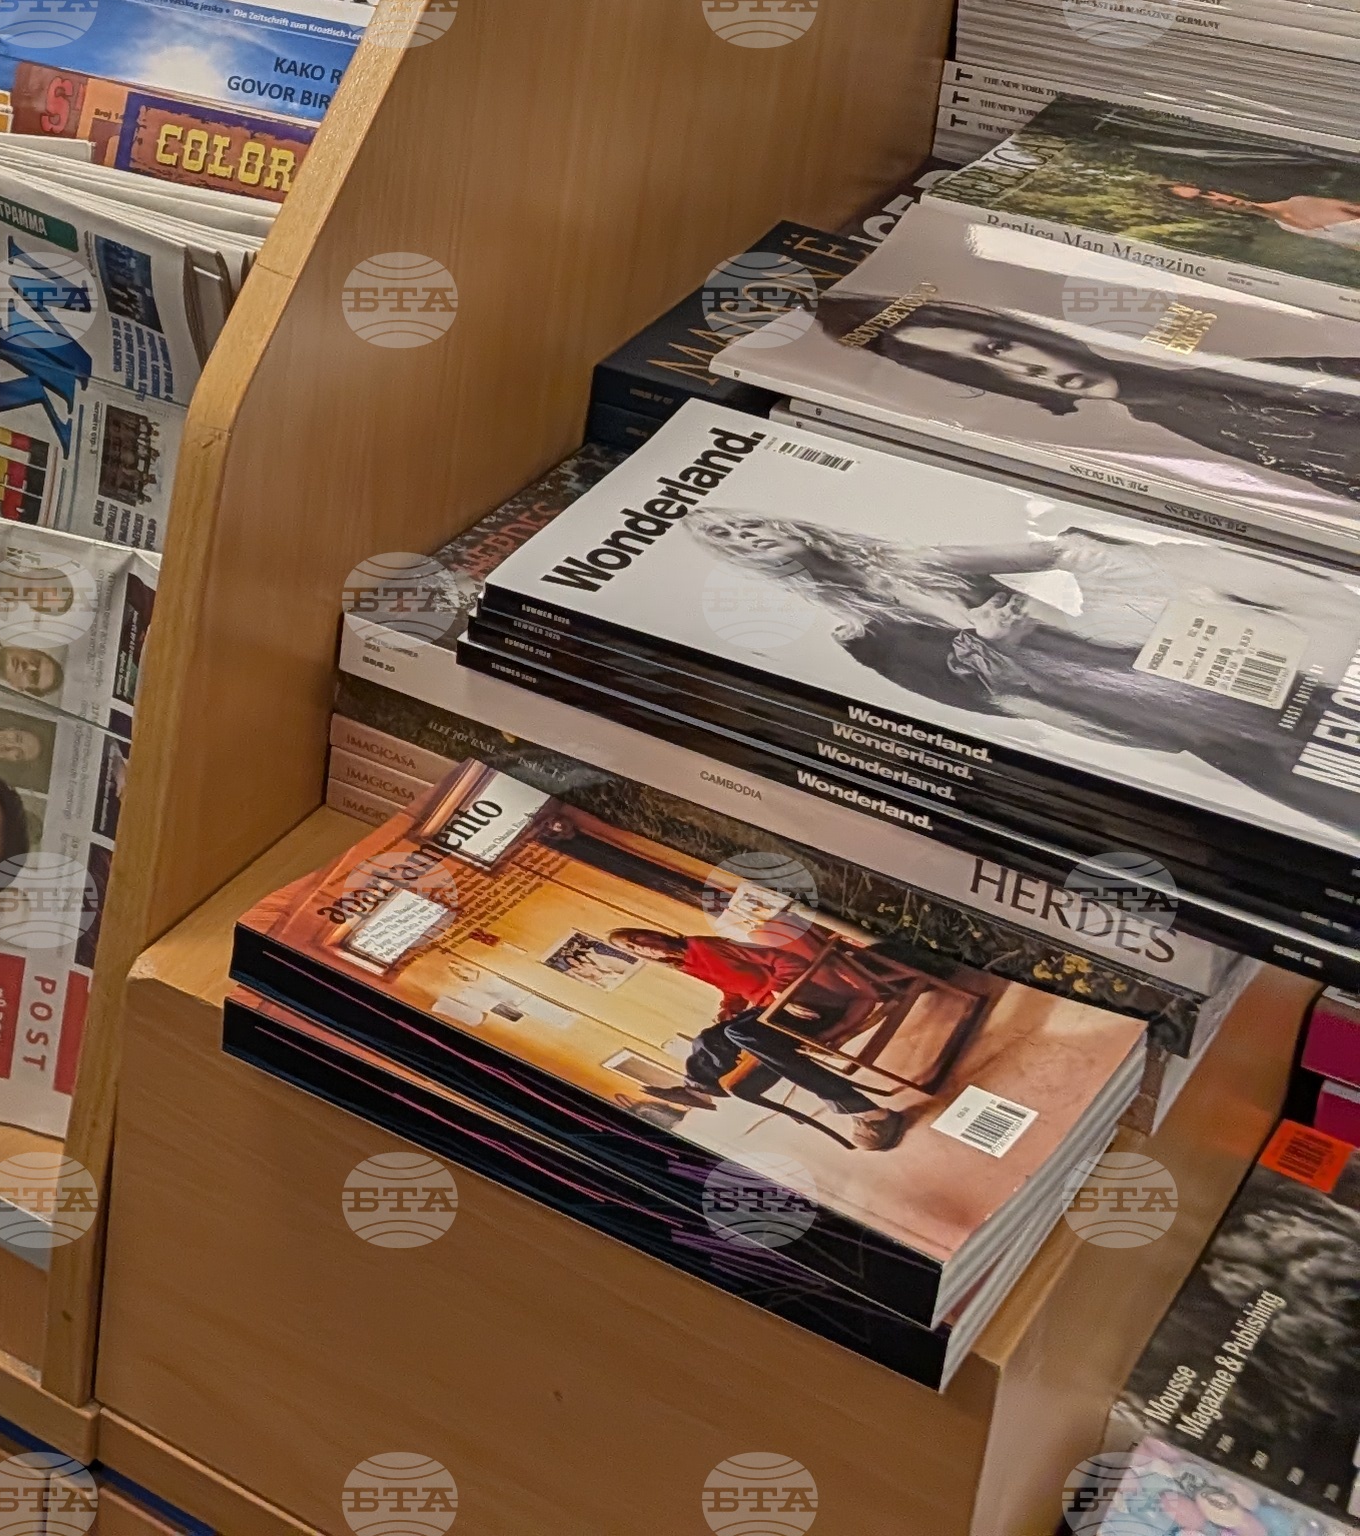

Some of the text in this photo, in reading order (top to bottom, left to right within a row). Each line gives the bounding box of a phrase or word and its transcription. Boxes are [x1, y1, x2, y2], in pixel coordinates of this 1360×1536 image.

[227, 74, 298, 103] GOVOR
[273, 56, 324, 82] KAKO
[1061, 229, 1106, 255] Man
[1111, 242, 1207, 279] Magazine
[541, 426, 768, 595] Wonderland.
[347, 734, 416, 769] IMAGICASA
[847, 705, 993, 765] Wonderland.
[699, 769, 763, 802] CAMBODIA
[795, 770, 935, 832] Wonderland.
[969, 858, 1176, 966] HERDES
[22, 974, 57, 1072] POST
[1143, 1363, 1198, 1426] Mousse
[1177, 1373, 1233, 1440] Magazine
[1224, 1290, 1287, 1365] Publishing
